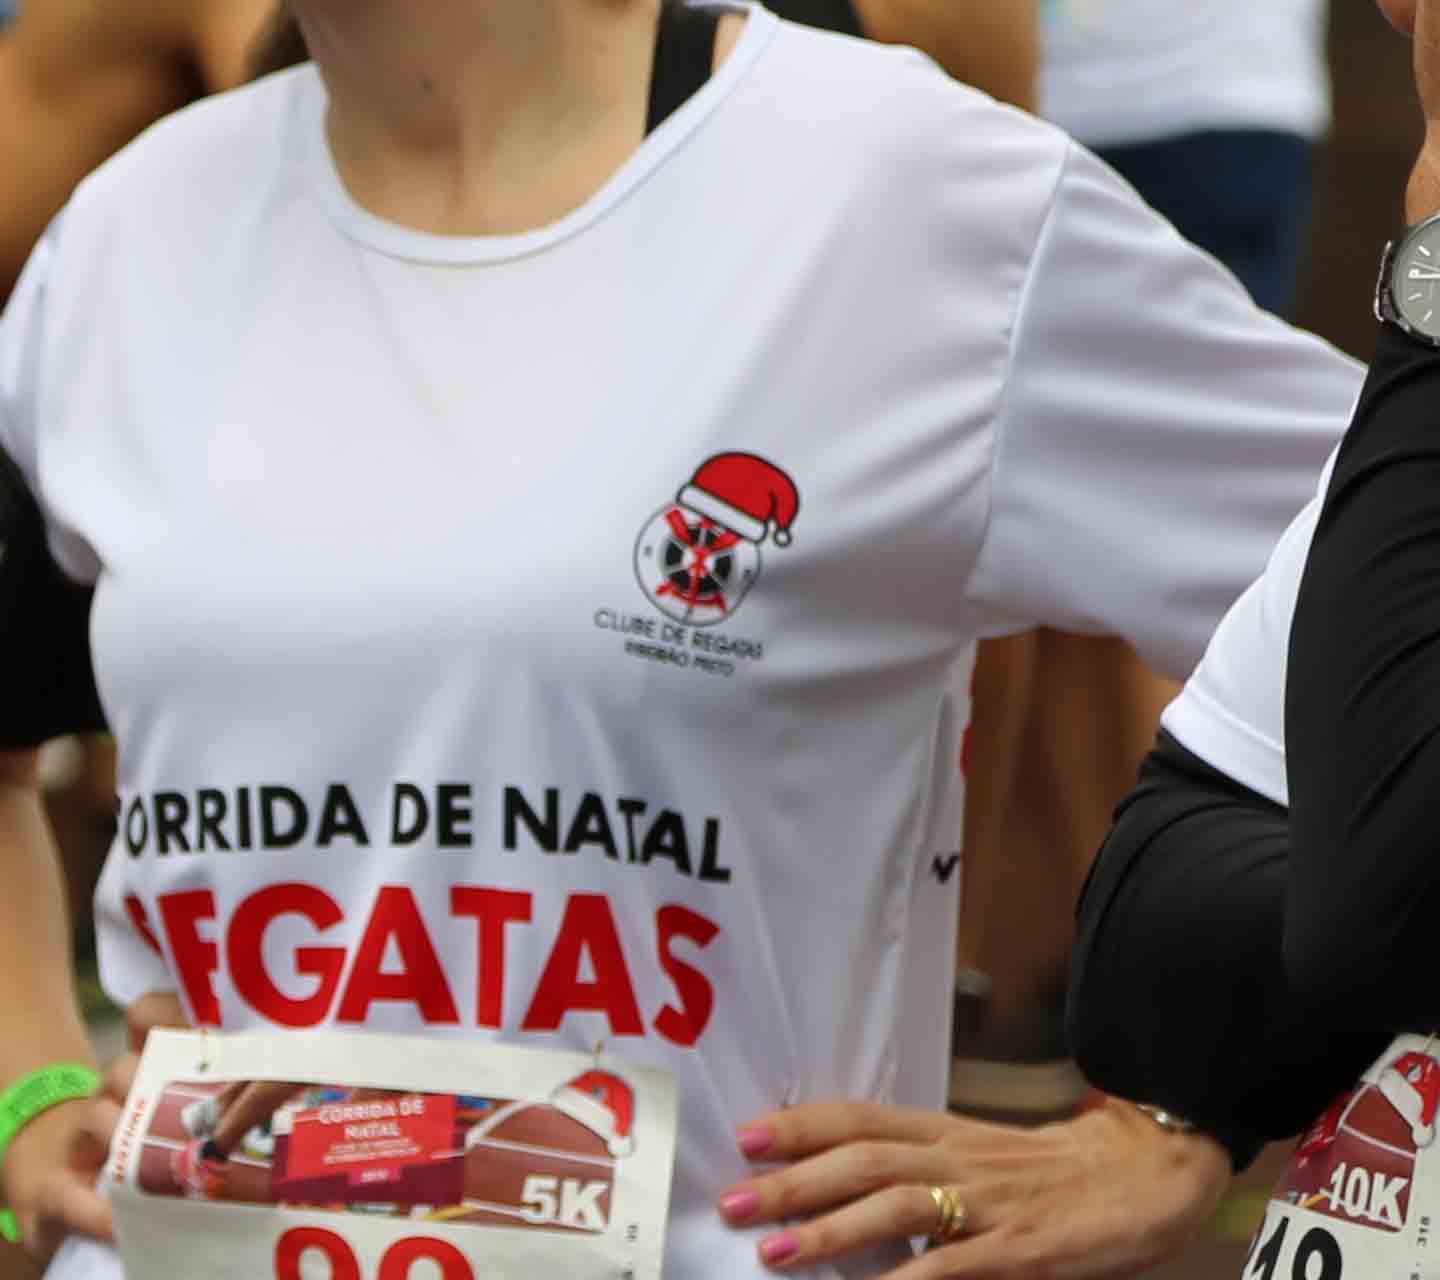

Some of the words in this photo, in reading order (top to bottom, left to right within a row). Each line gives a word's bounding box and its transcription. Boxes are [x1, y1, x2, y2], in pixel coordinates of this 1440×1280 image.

[594, 608, 656, 639] CLUBE
[661, 623, 686, 646] DE
[118, 782, 371, 860] ORRIDA
[390, 782, 475, 850] DE
[502, 787, 733, 884] NATAL
[520, 1173, 610, 1231] 5K
[1327, 1161, 1410, 1230] 10K
[1417, 1215, 1432, 1247] 318
